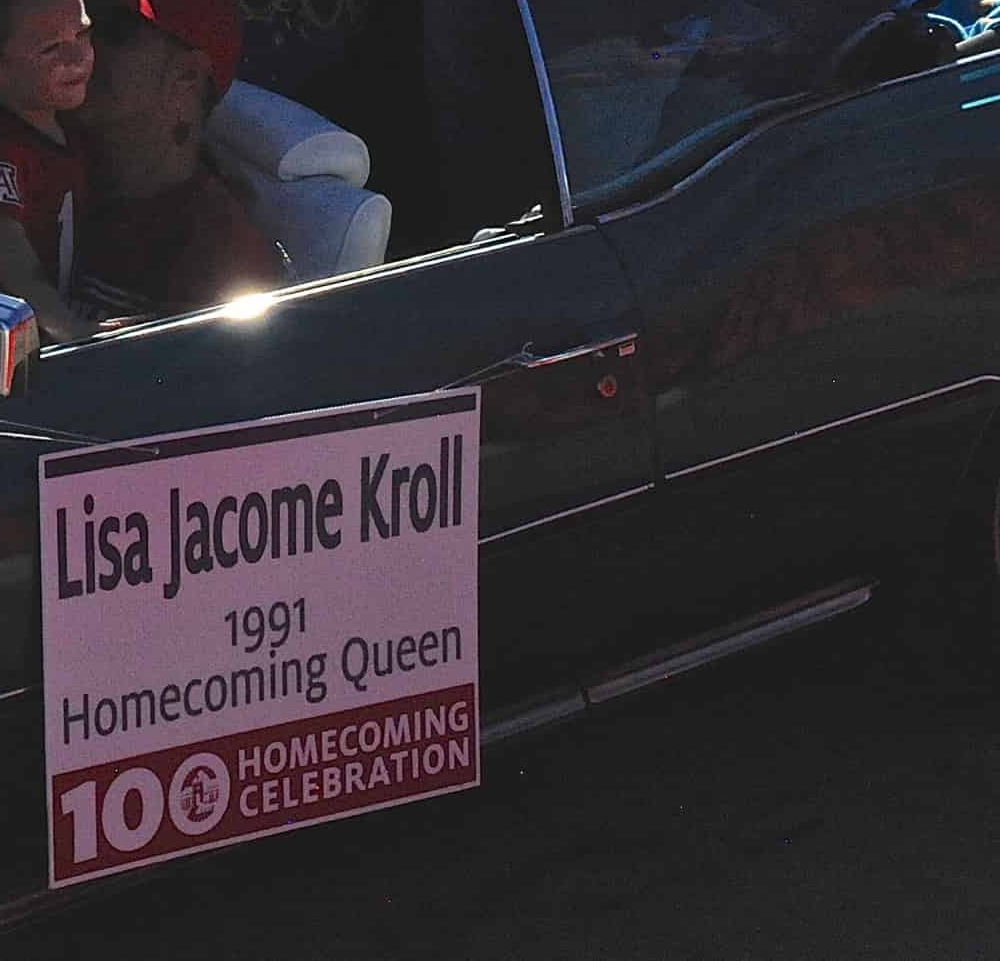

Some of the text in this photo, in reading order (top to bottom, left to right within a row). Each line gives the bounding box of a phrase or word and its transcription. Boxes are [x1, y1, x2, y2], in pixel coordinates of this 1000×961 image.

[57, 434, 463, 600] Lisa Jacome Kroll
[225, 598, 305, 653] 1991
[62, 626, 462, 745] Homecoming Queen
[59, 701, 469, 865] 100 HOMECOMING
[239, 736, 472, 819] CELEBRATION
